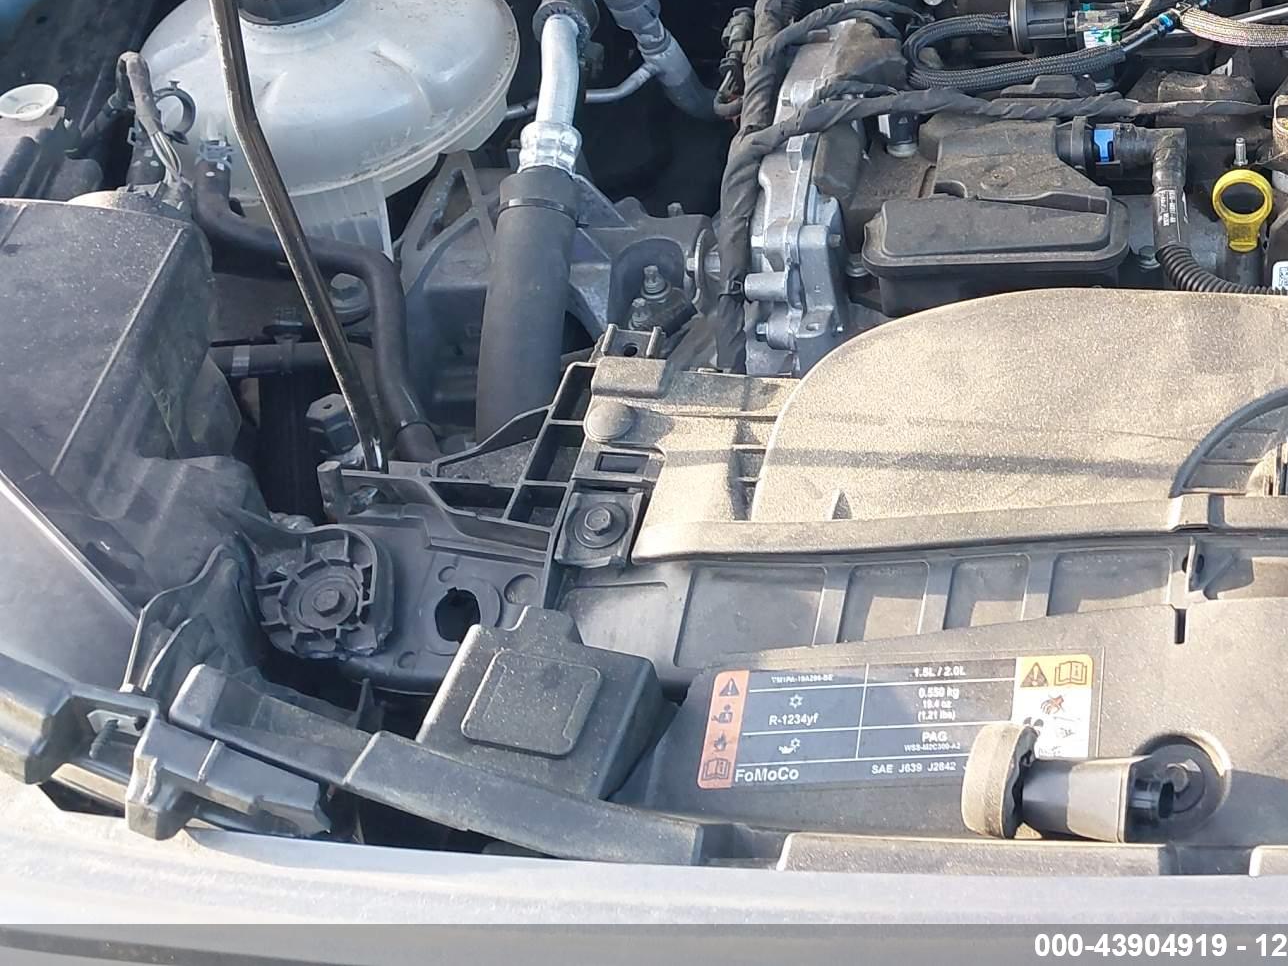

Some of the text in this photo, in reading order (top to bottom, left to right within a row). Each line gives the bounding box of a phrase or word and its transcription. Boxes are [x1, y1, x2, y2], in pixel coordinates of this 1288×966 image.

[913, 667, 936, 677] 1.5L
[944, 665, 967, 676] 2.0L
[947, 686, 960, 700] kg
[769, 713, 819, 726] R-1234yf
[922, 731, 948, 742] PAG
[735, 767, 800, 782] FoMoCo
[871, 764, 894, 774] SAE
[899, 763, 923, 773] J639
